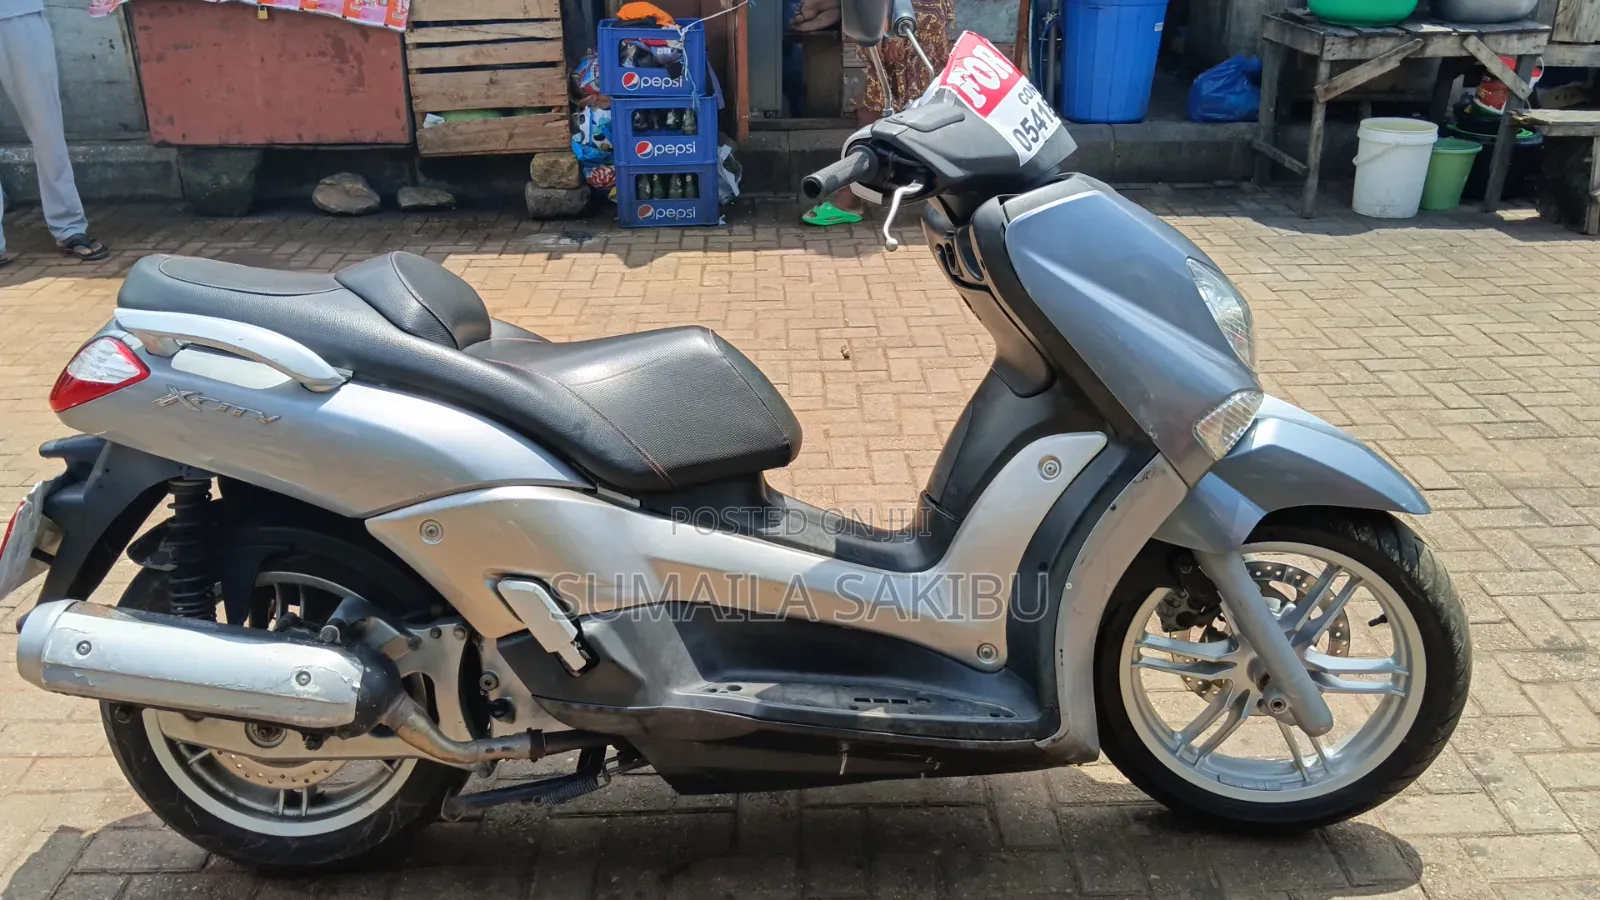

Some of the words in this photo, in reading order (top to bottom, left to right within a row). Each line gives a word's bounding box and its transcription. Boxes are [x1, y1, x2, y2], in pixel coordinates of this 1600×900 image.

[640, 75, 683, 89] pepsi
[946, 44, 1013, 108] FOR
[654, 141, 696, 157] pepsi
[655, 206, 696, 220] pepsi
